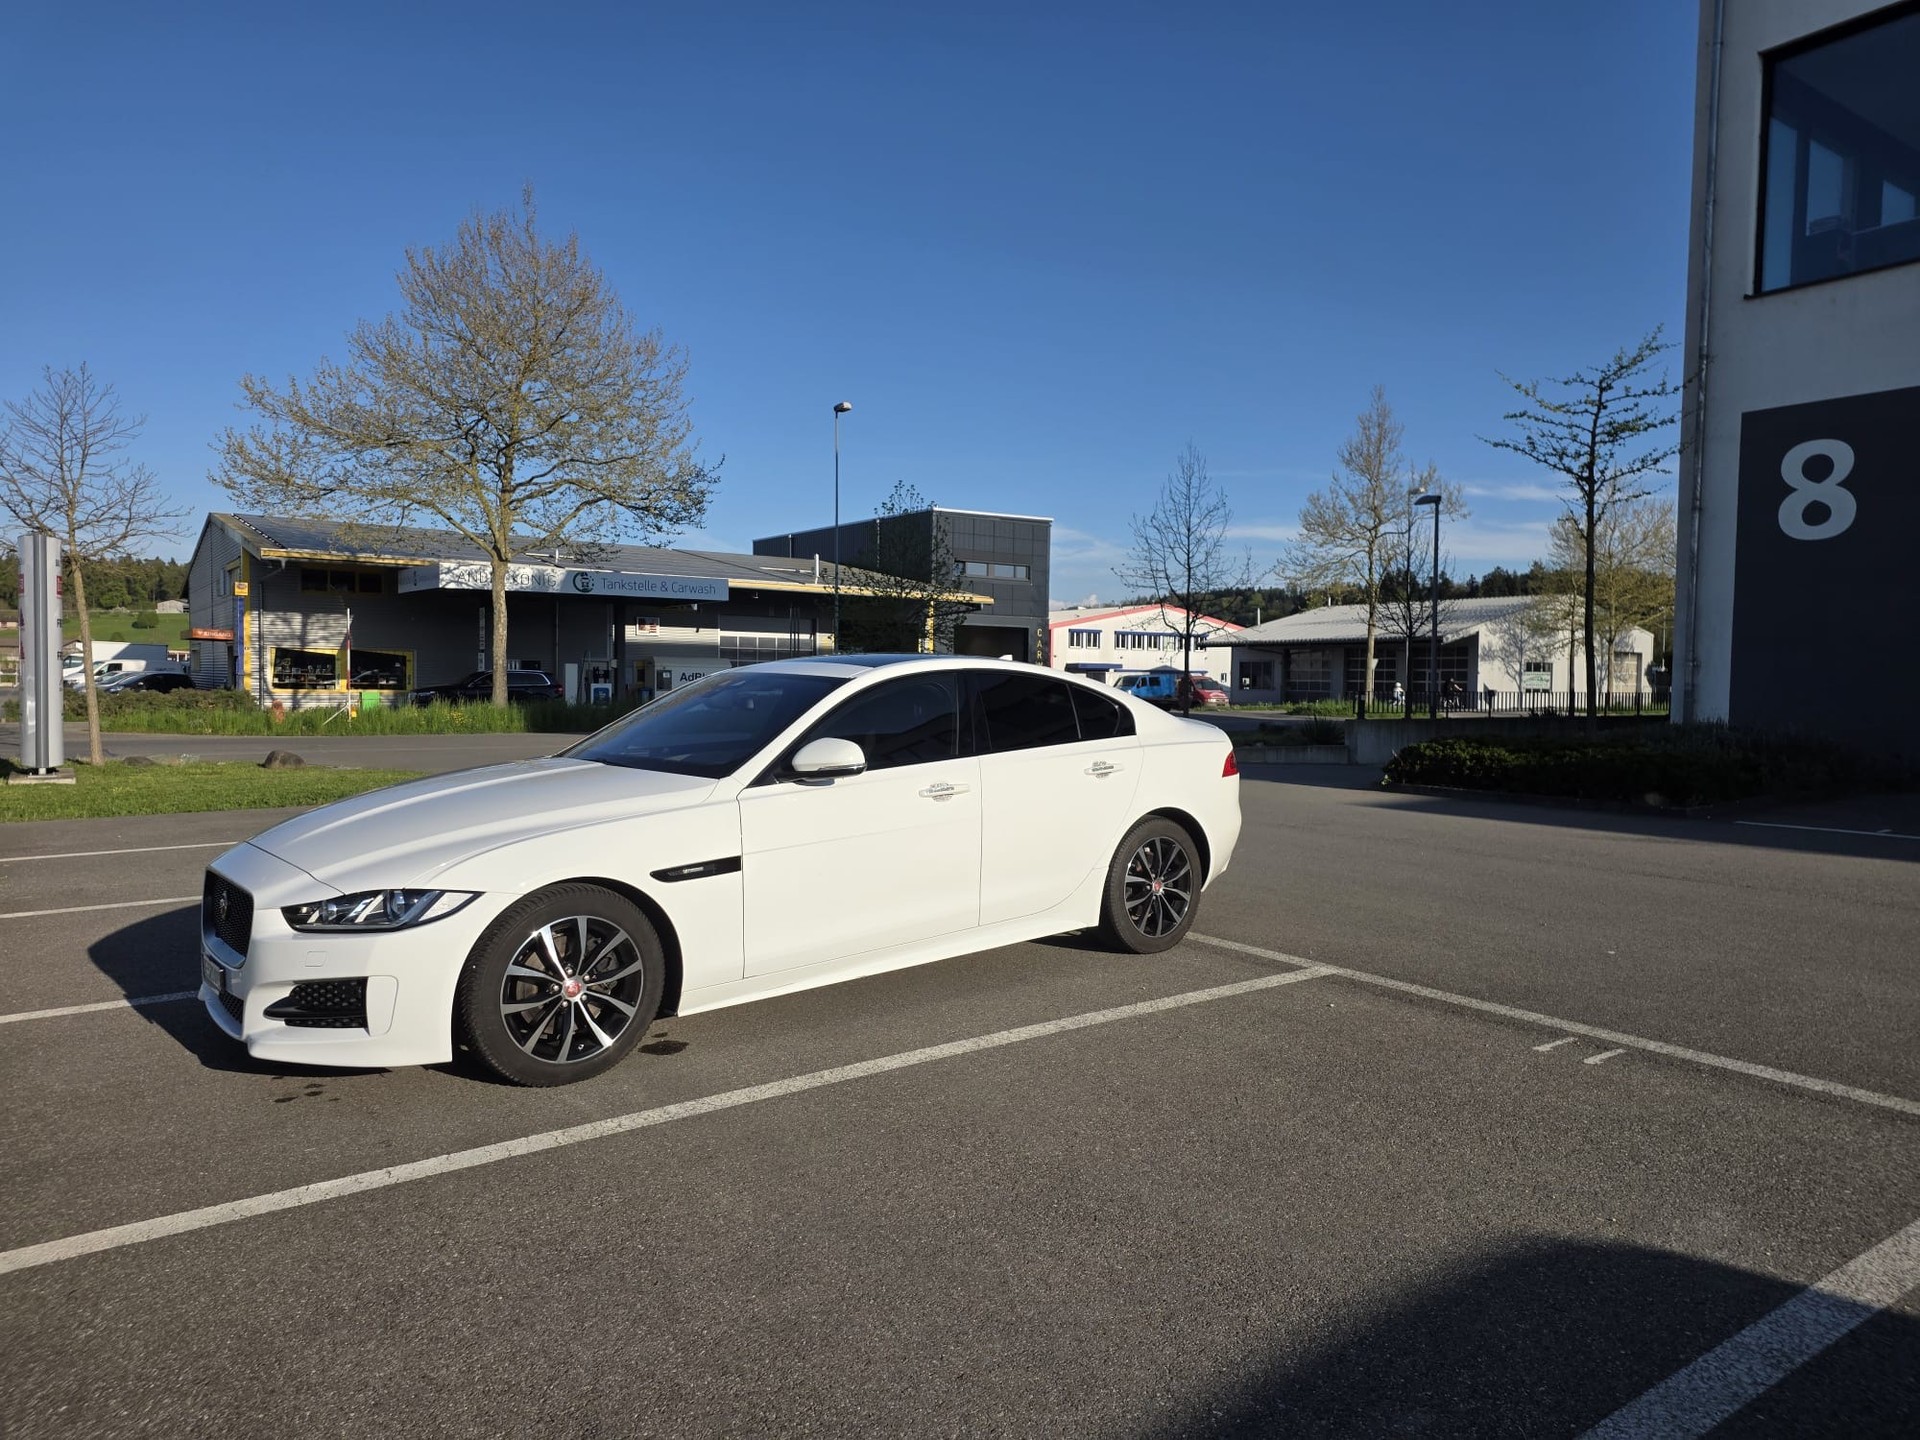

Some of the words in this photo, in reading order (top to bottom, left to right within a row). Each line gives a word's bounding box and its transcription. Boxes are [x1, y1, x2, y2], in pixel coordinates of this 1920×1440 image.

[1778, 438, 1857, 541] 8
[458, 569, 496, 585] AND
[601, 577, 657, 592] Tankstelle
[660, 581, 669, 592] &
[671, 581, 716, 595] Carwash
